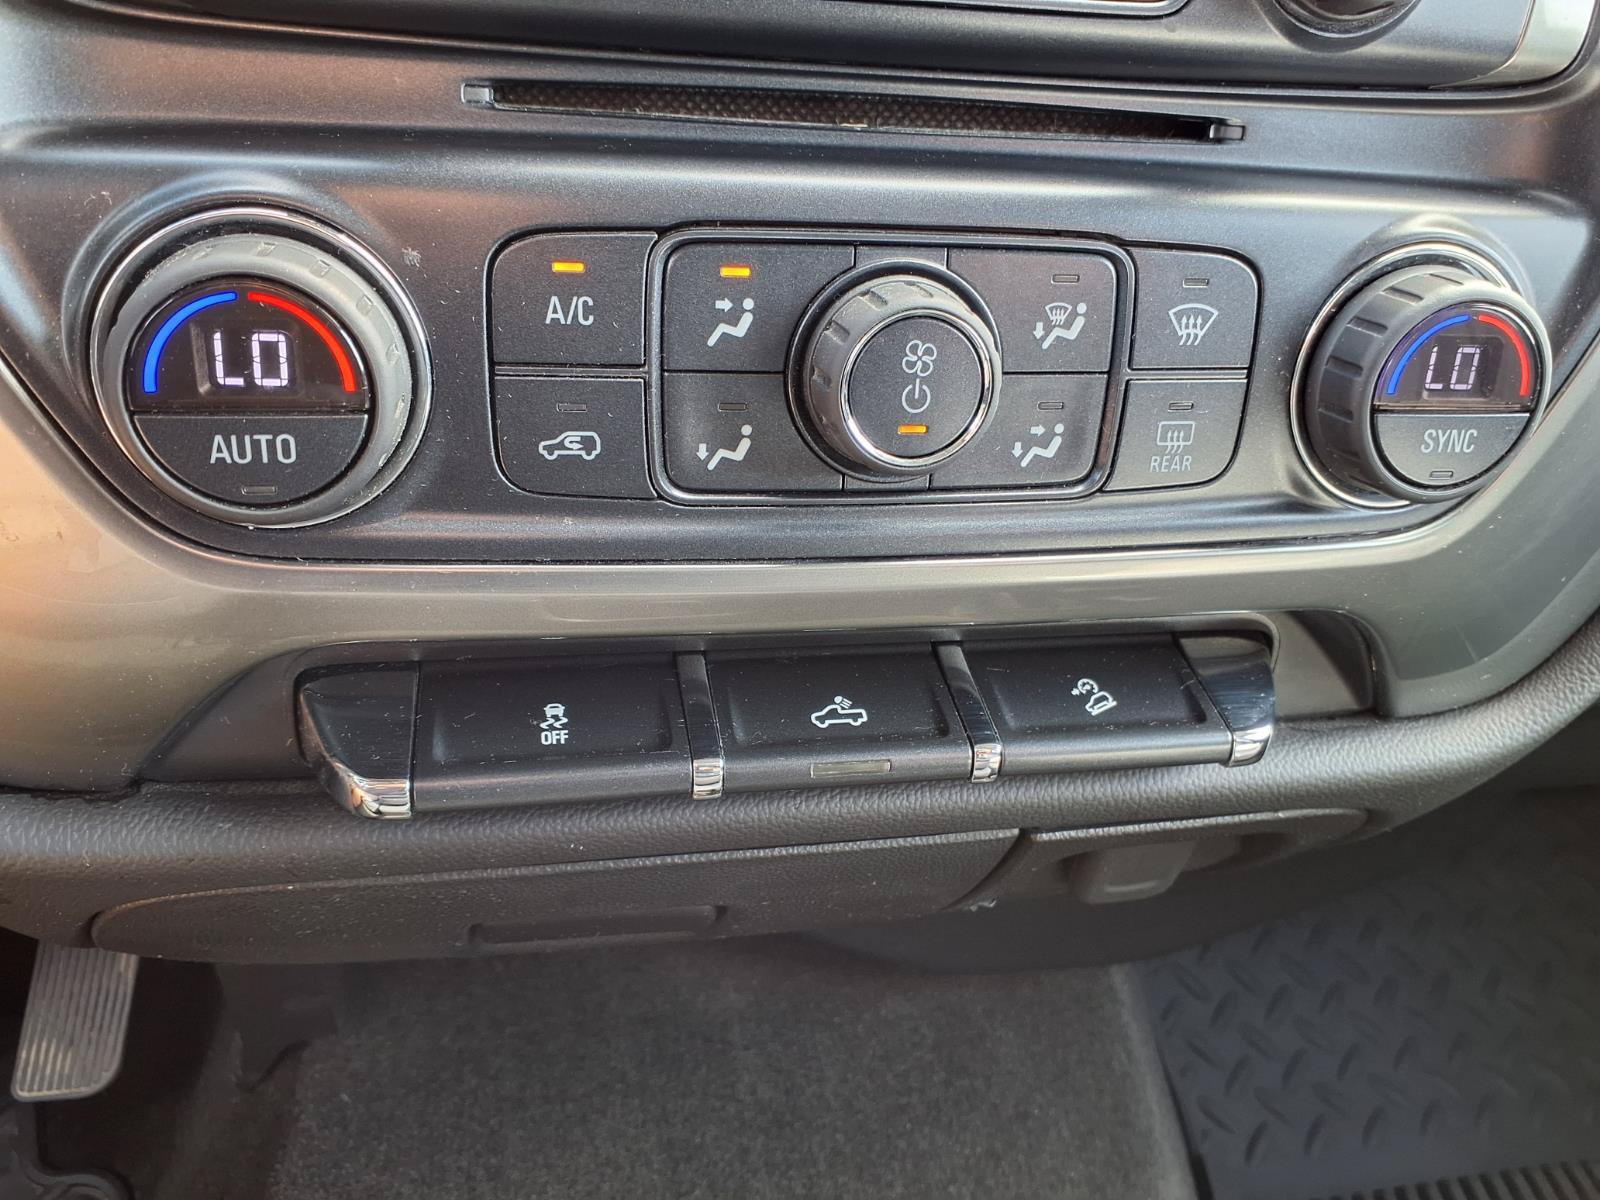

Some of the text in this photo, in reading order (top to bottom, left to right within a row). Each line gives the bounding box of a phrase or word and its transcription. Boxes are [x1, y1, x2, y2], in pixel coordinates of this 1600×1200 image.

[545, 295, 595, 326] A/C
[209, 433, 297, 465] AUTO
[1420, 428, 1478, 454] SYNC
[1149, 455, 1193, 473] REAR
[540, 729, 569, 746] OFF
